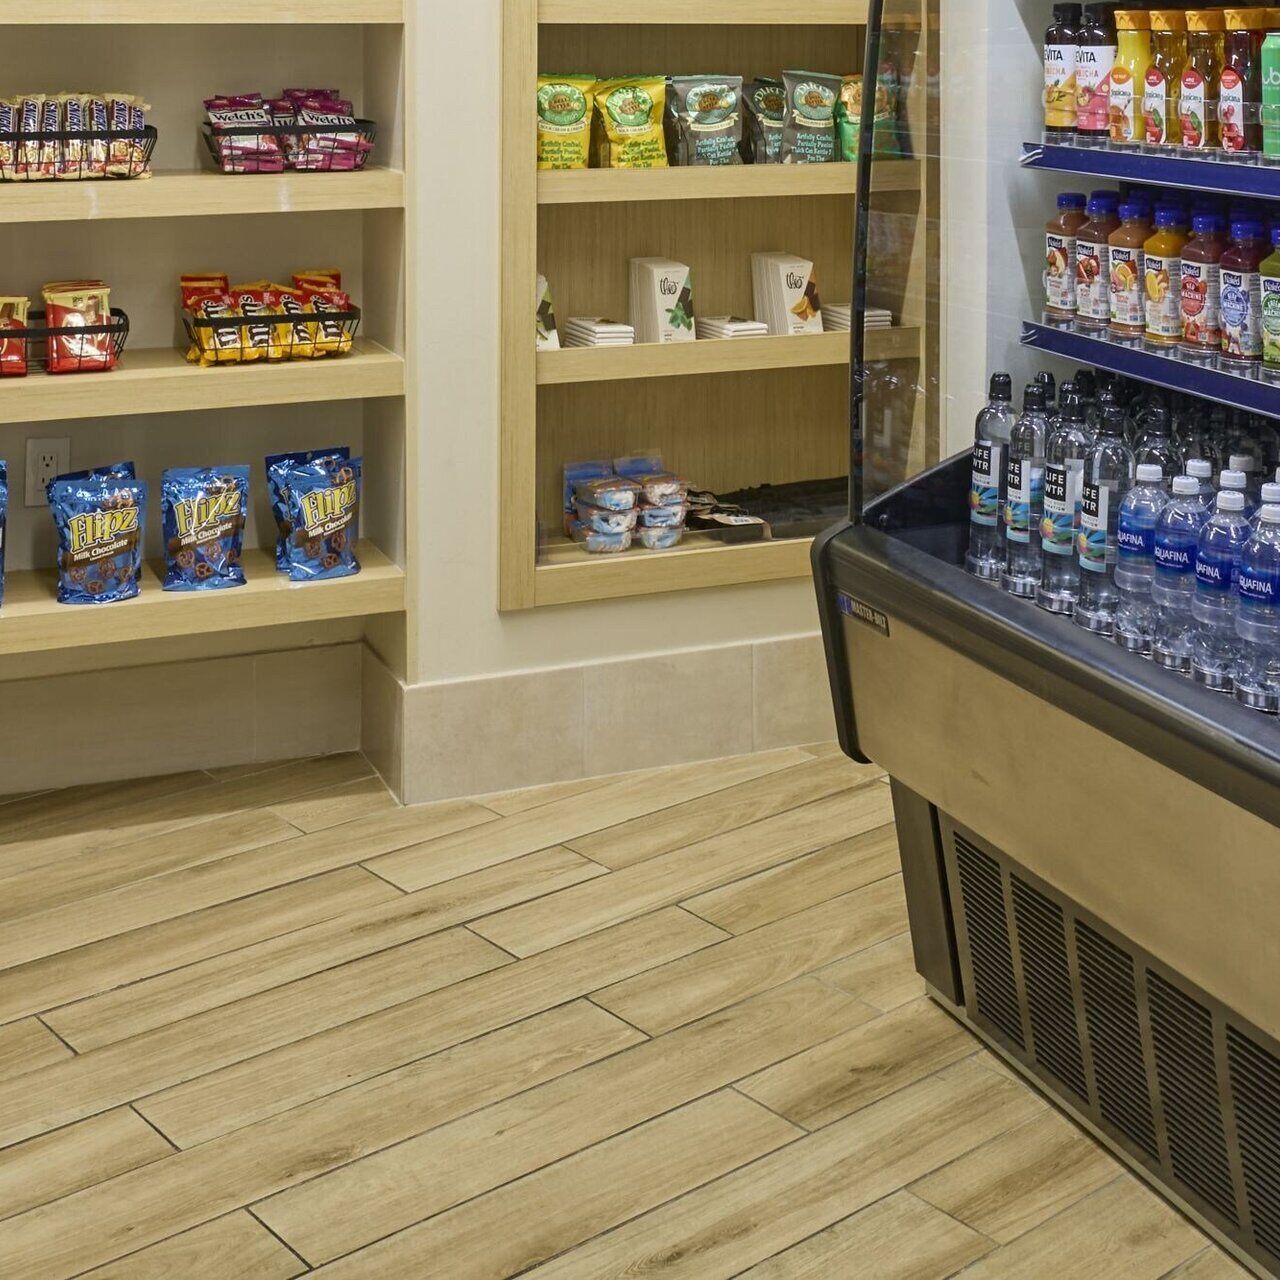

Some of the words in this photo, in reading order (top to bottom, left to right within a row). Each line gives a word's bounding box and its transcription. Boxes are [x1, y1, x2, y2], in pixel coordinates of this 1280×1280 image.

[212, 110, 264, 123] Welch's
[1046, 471, 1065, 485] LIFE
[1045, 483, 1064, 498] WTR
[174, 490, 241, 539] Flipz
[300, 480, 357, 530] Flipz
[67, 505, 139, 554] Flipz
[91, 538, 129, 557] Chocolate
